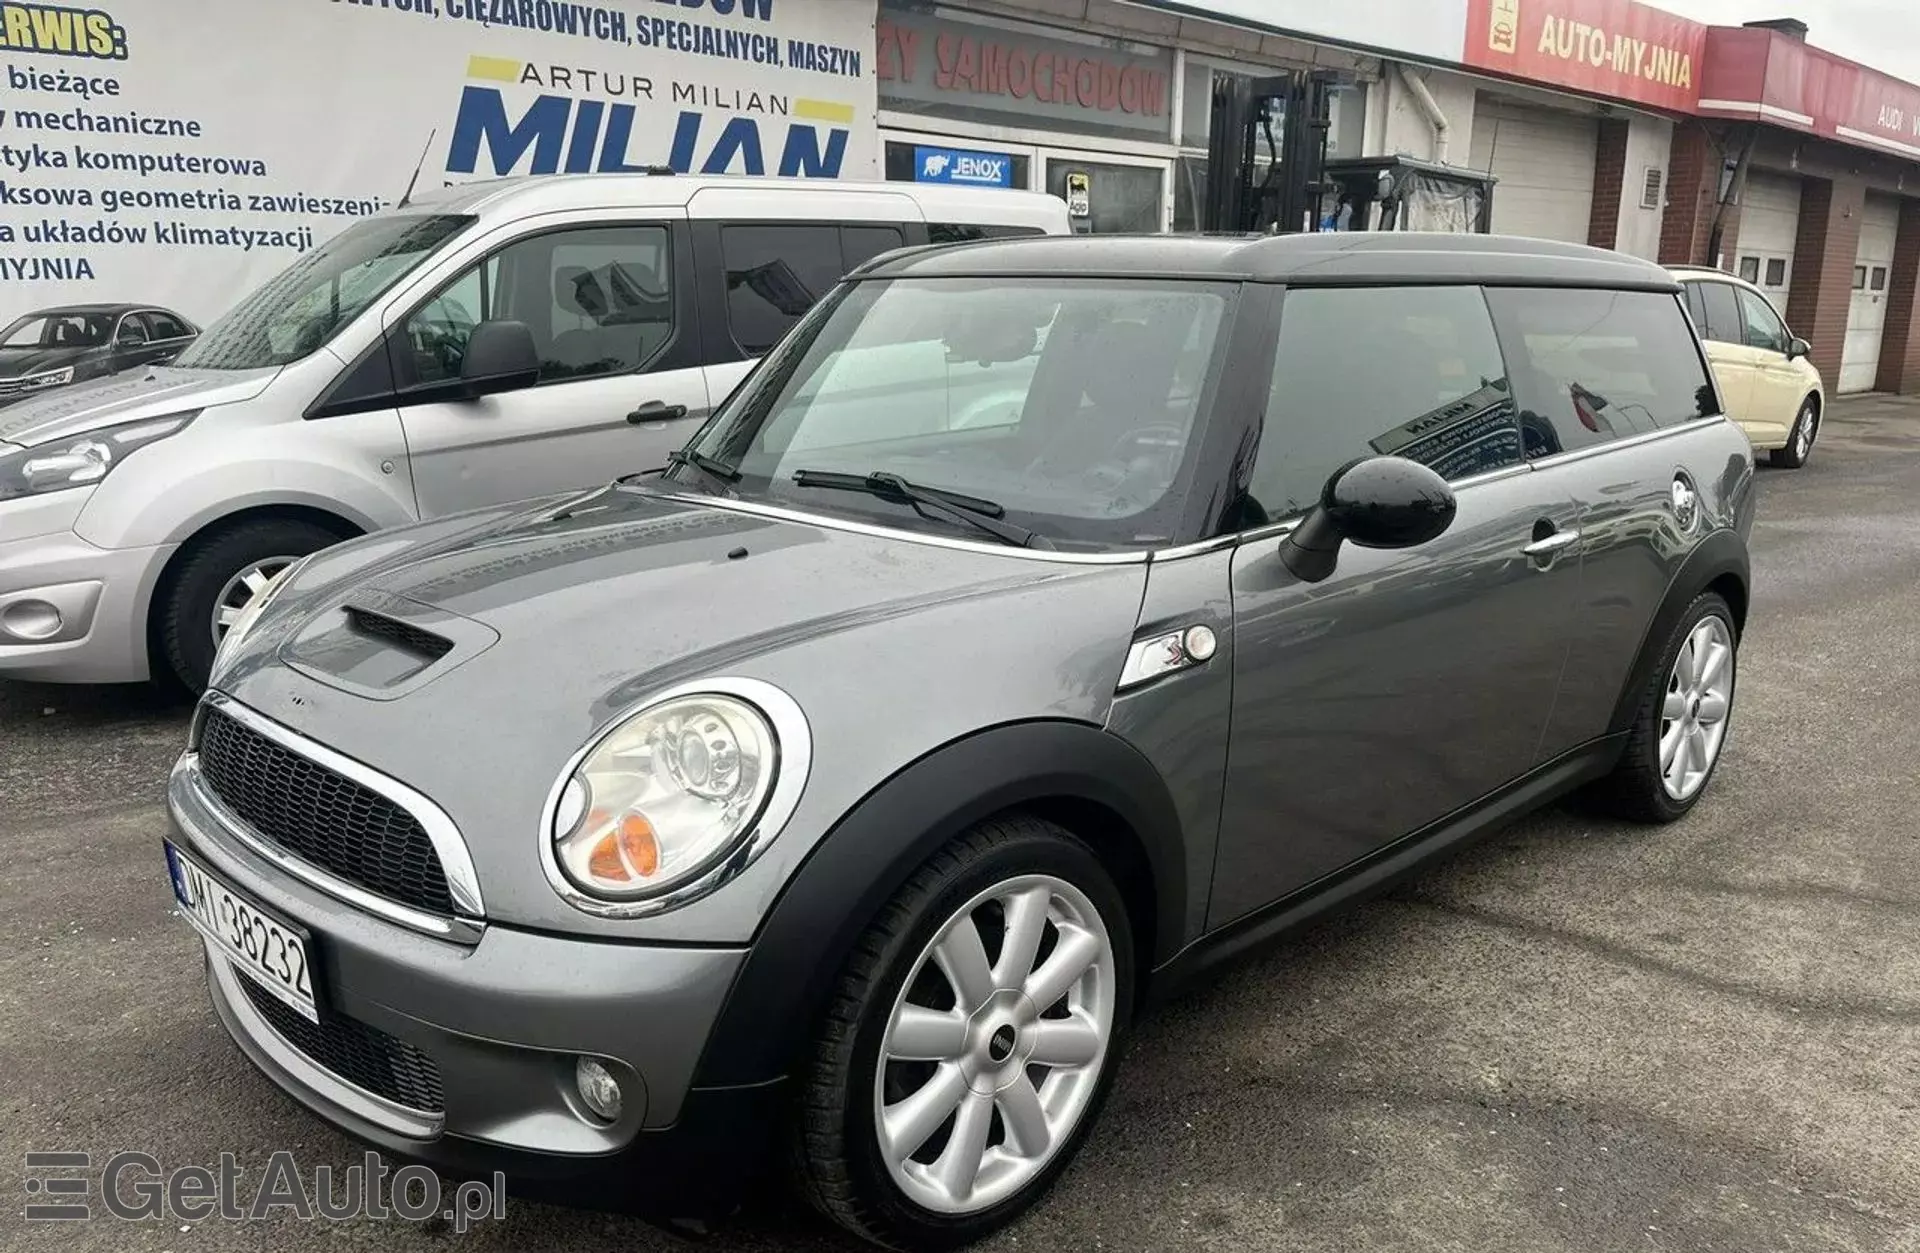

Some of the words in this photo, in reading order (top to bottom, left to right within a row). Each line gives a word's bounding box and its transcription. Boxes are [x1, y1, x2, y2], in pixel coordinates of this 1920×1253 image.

[0, 4, 127, 59] RWIS:
[636, 15, 783, 69] SPECJALNYCH,
[788, 39, 861, 77] MASZYN
[1538, 14, 1691, 89] AUTO-MYJNIA
[8, 65, 120, 100] bieżące
[520, 62, 653, 99] ARTUR
[672, 81, 788, 115] MILIAN
[14, 108, 201, 137] mechaniczne
[445, 85, 850, 179] MILIAN
[1877, 104, 1904, 132] AUDI
[0, 143, 67, 172] tyka
[75, 145, 267, 177] komputerowa
[951, 157, 1002, 178] JENOX
[101, 188, 242, 213] geometria
[248, 192, 391, 217] zawieszeni
[24, 219, 147, 244] układów
[154, 221, 313, 251] klimatyzacji
[224, 893, 313, 1000] 38232
